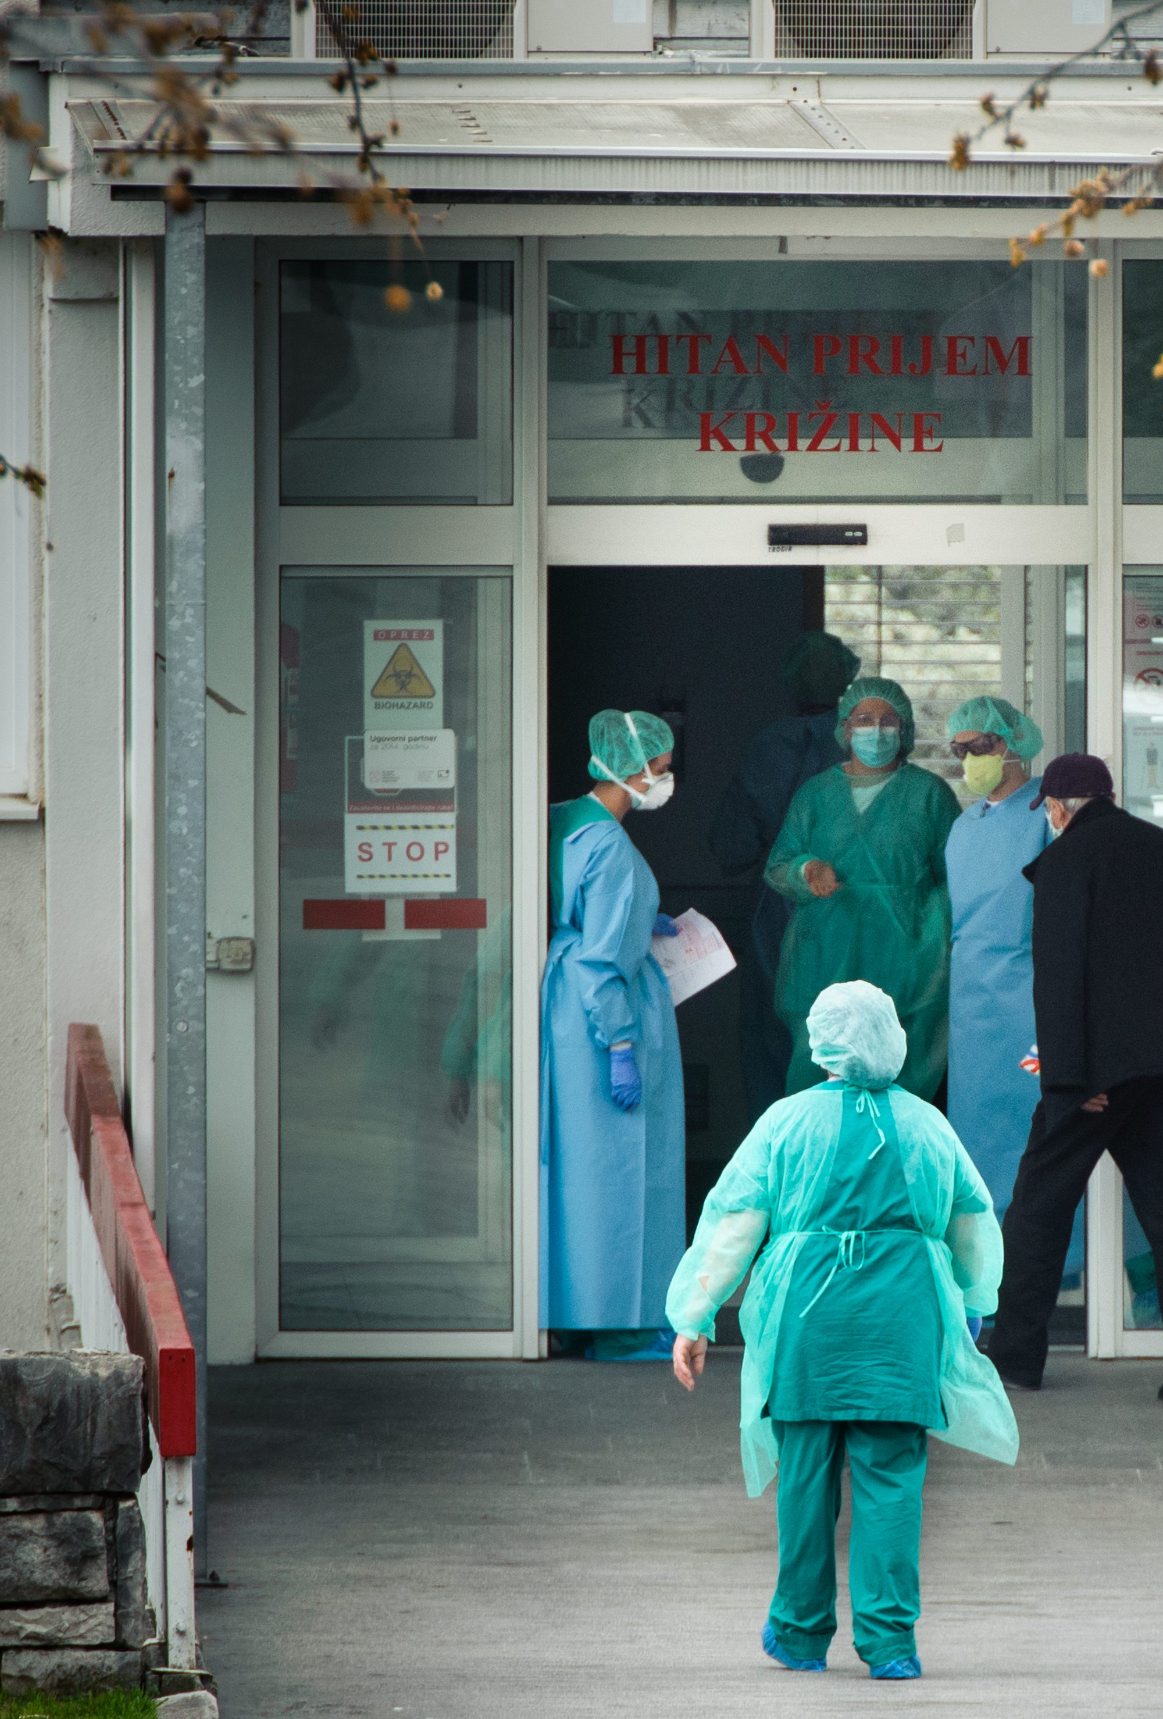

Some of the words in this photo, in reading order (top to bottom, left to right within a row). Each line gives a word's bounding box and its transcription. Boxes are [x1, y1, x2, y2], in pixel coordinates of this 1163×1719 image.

[608, 334, 791, 376] HITAN
[812, 335, 1034, 376] PRIJEM
[696, 400, 945, 453] KRIŽINE
[378, 630, 431, 640] OPREZ
[374, 701, 434, 711] BIOHAZARD
[369, 735, 405, 744] Ugovorni
[407, 735, 438, 744] partner
[357, 841, 449, 862] STOP
